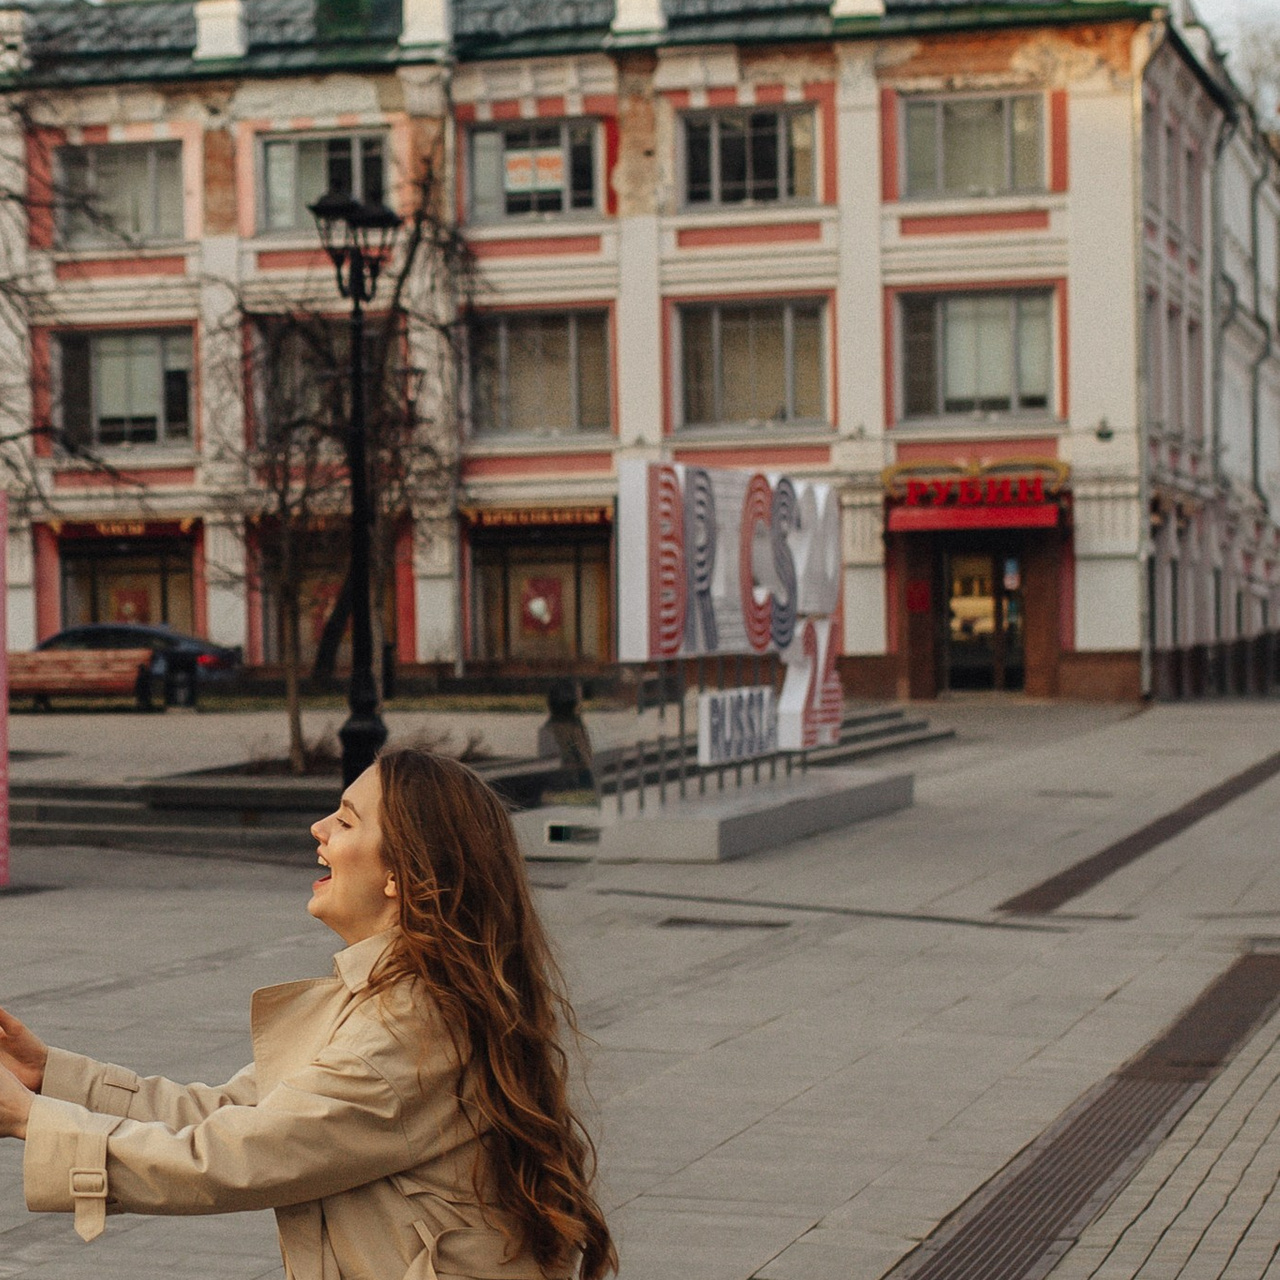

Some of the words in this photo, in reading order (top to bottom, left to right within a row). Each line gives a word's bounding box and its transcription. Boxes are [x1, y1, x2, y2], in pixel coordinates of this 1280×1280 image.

[906, 474, 1045, 506] РУБИН
[649, 464, 803, 659] BRICS
[709, 688, 777, 761] RUSSIA
